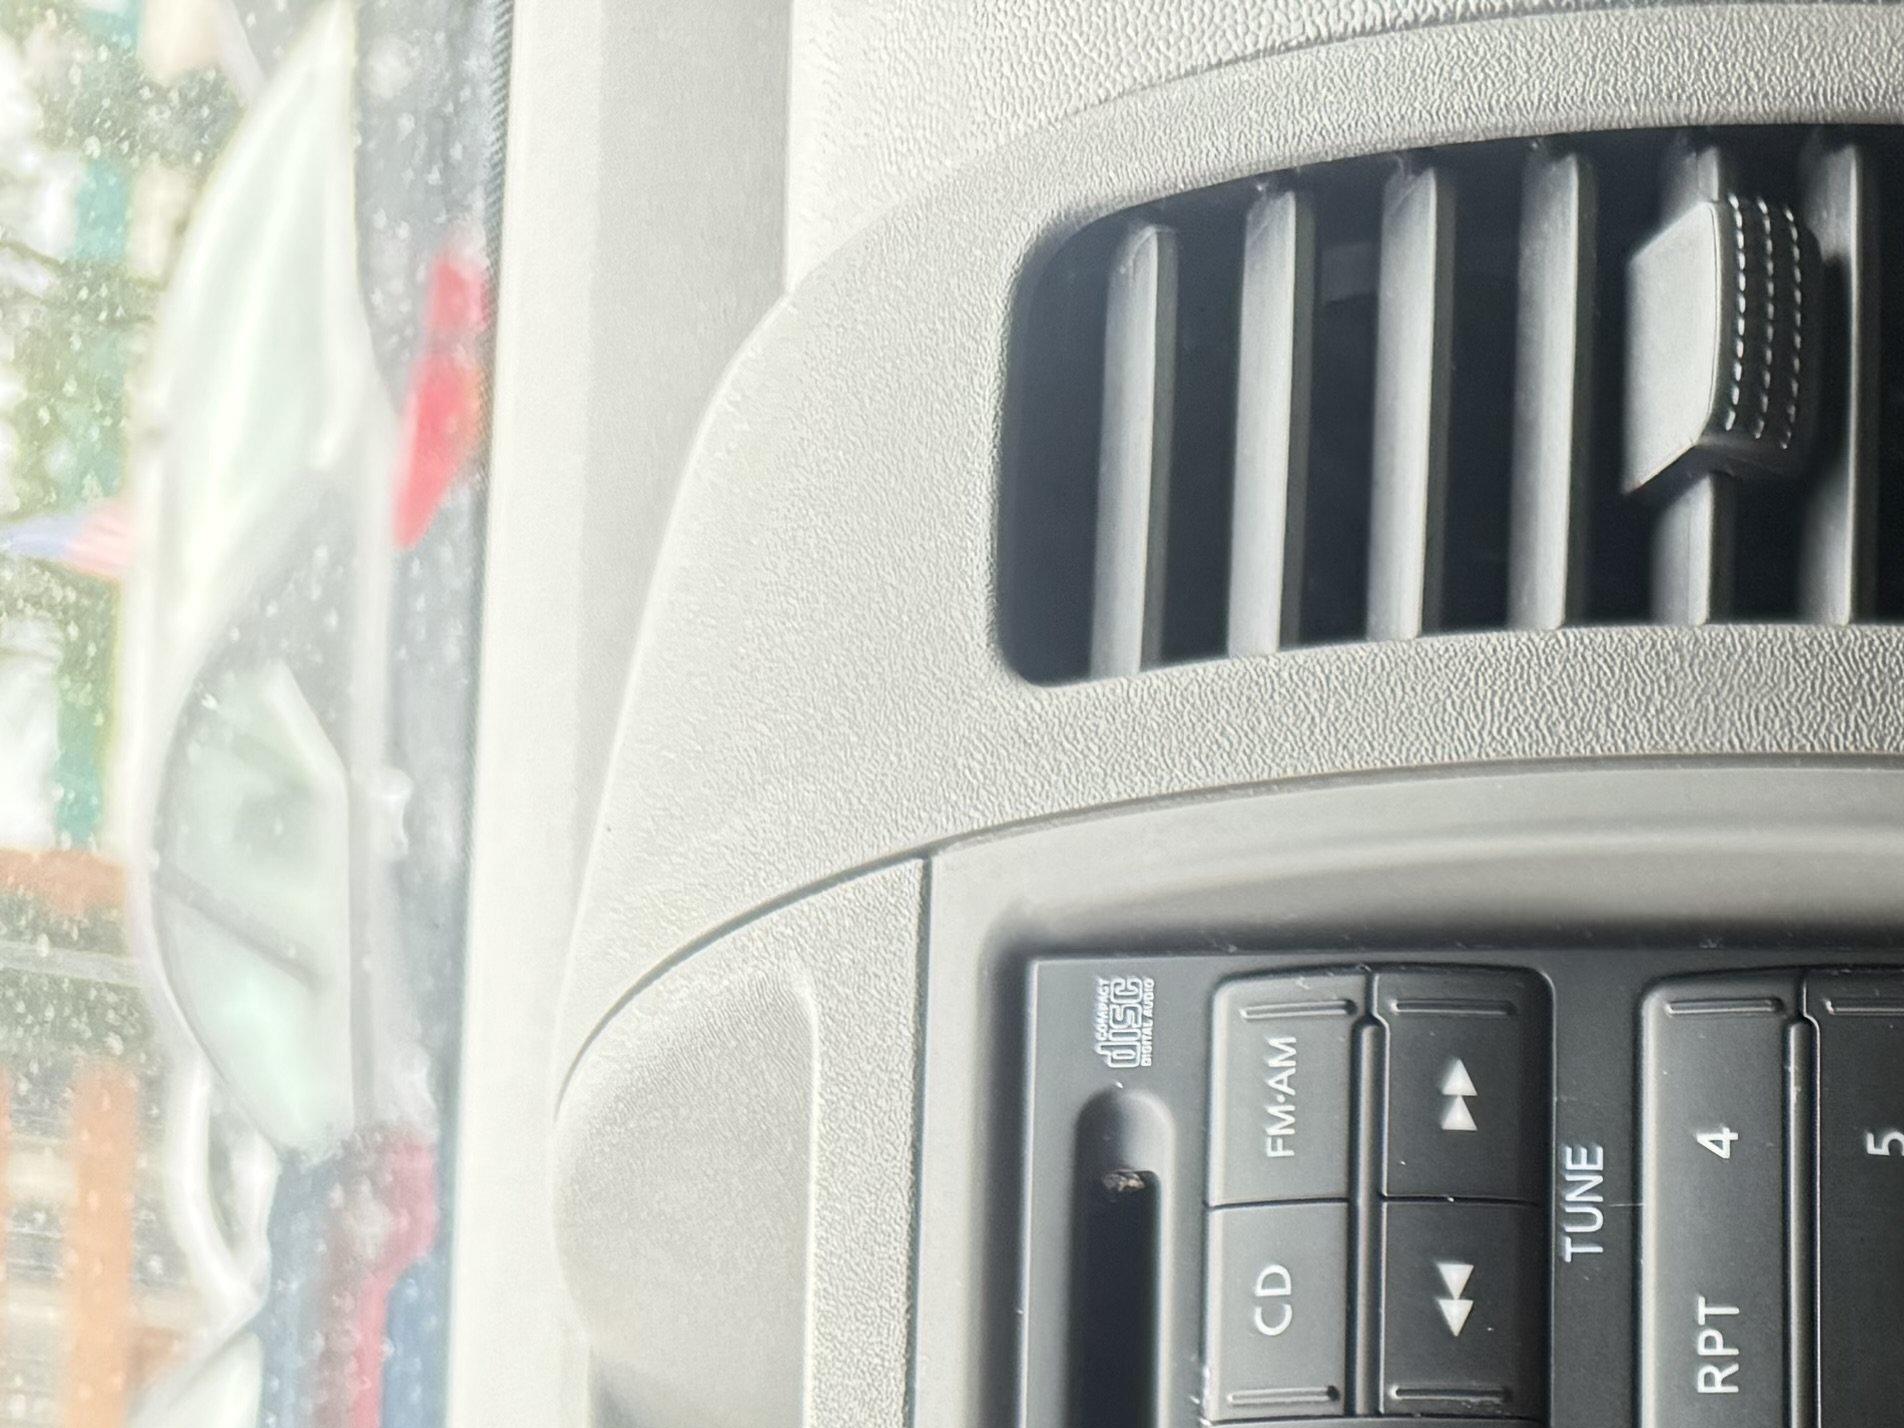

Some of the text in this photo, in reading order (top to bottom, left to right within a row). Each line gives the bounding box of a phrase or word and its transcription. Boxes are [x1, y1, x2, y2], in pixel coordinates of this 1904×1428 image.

[1095, 978, 1142, 1067] disc
[1096, 978, 1109, 1041] COMPACT
[1141, 978, 1154, 1066] DIGITAL AUDIO
[1565, 1147, 1603, 1262] TUNE
[1254, 1265, 1292, 1335] CD
[1696, 1127, 1739, 1393] RPT 4
